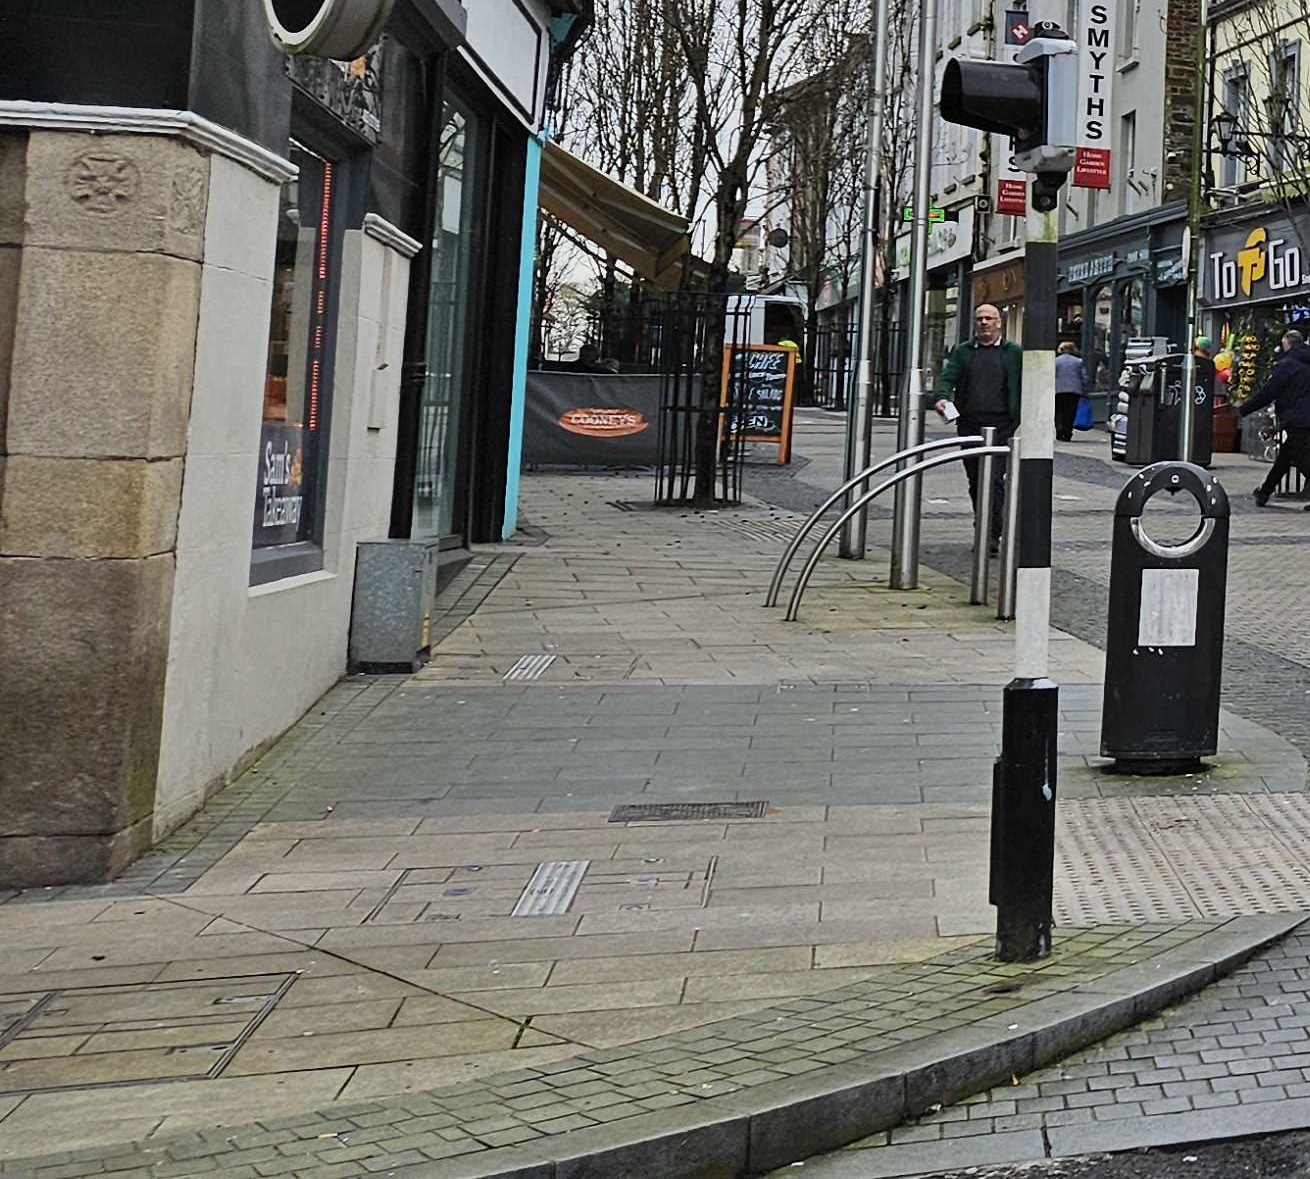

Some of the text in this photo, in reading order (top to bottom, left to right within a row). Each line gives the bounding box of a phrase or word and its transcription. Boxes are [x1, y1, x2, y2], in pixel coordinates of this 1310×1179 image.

[1085, 4, 1110, 140] SMYTHS
[1210, 252, 1236, 300] To
[1268, 239, 1300, 290] Go
